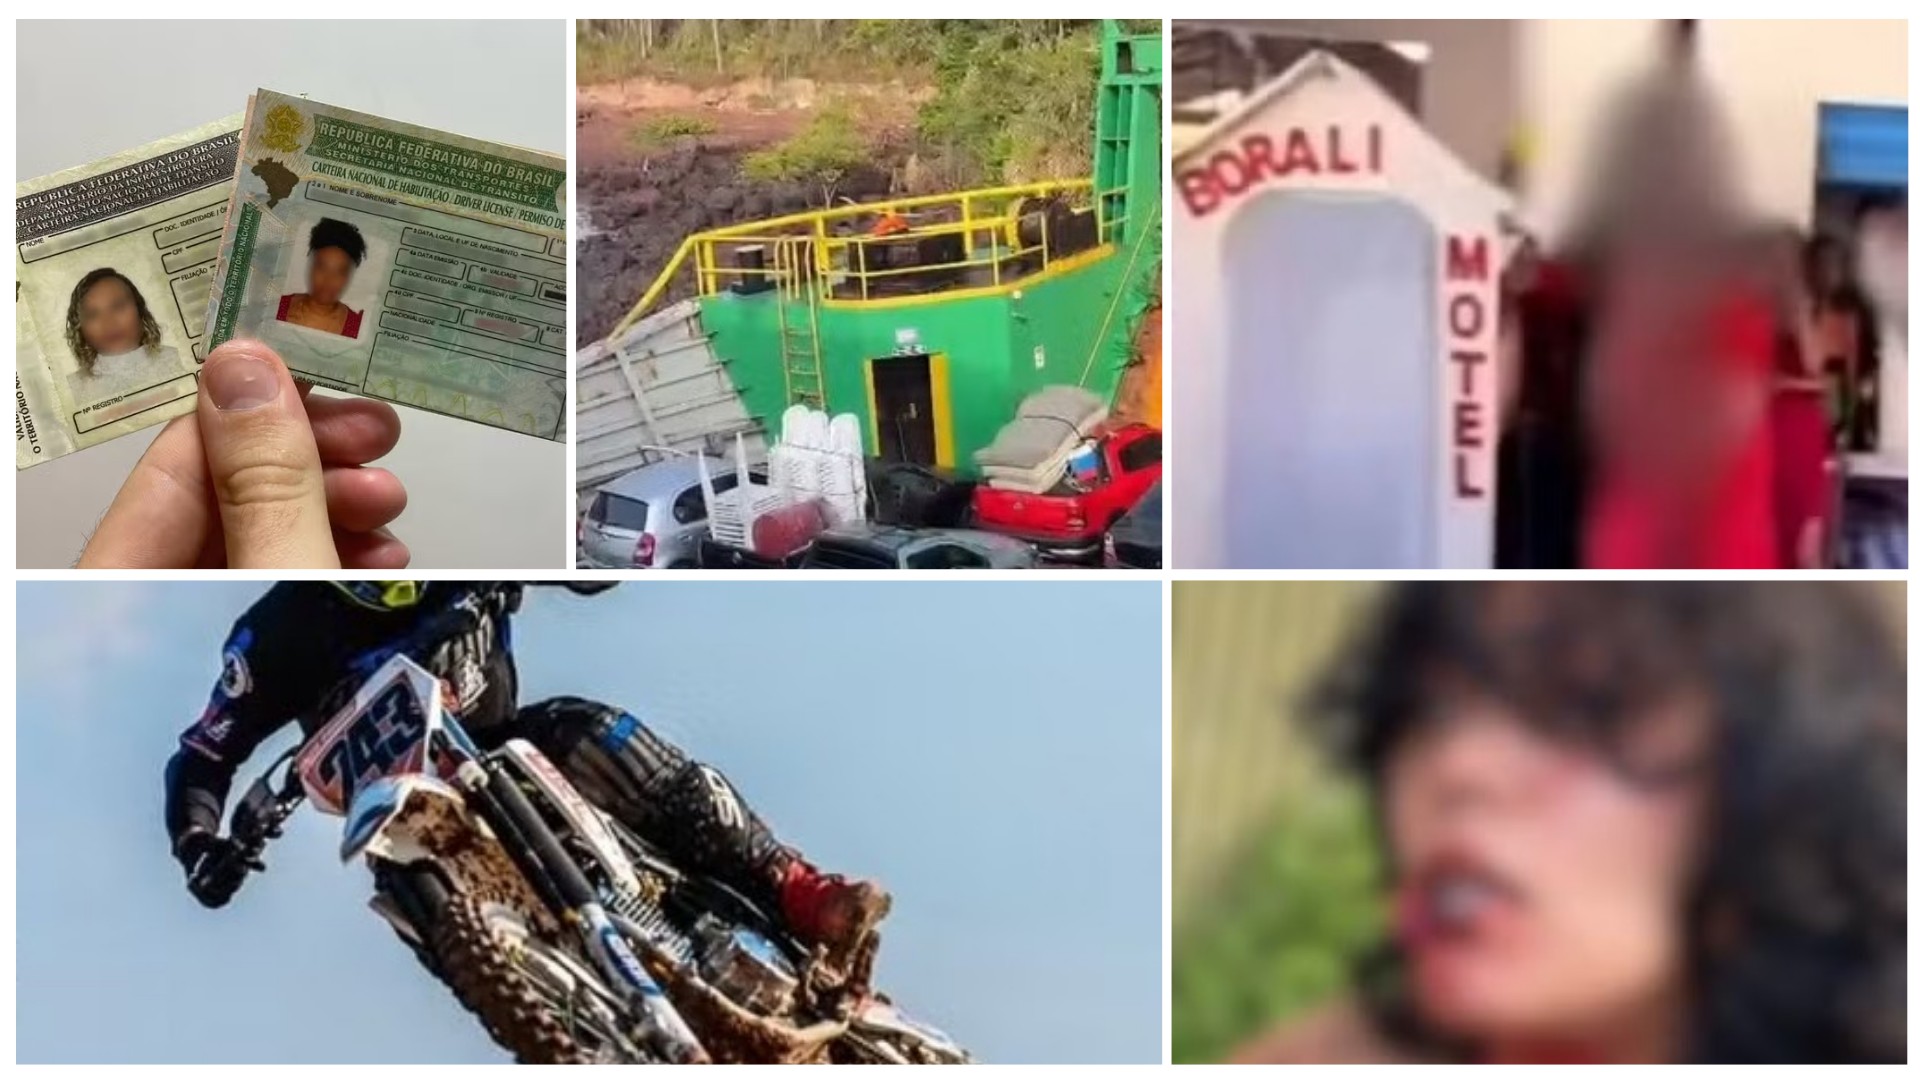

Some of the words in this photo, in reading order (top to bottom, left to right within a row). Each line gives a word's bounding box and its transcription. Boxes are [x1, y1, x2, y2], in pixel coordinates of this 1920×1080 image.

[90, 160, 165, 189] FEDERATIVA
[168, 151, 189, 164] DO
[192, 136, 234, 155] BRASIL
[108, 182, 124, 192] DA
[126, 153, 214, 186] INFRAESTRUTURA
[326, 149, 394, 170] SECRETARIA
[399, 166, 456, 186] NACIONAL
[461, 181, 476, 190] DE
[399, 141, 478, 170] FEDERATIVA
[483, 160, 502, 175] DO
[507, 166, 554, 188] BRASIL
[414, 160, 437, 170] DOS
[444, 167, 529, 193] TRANSPORTES
[16, 198, 101, 228] DEPARTAMENTO
[104, 180, 158, 201] NACIONAL
[160, 176, 171, 184] DE
[312, 161, 346, 179] CARTEIRA
[348, 172, 386, 188] NACIONAL
[388, 180, 398, 190] DE
[454, 194, 483, 209] DRIVER
[483, 200, 514, 218] LICENSE
[518, 209, 553, 226] PERMISO
[330, 184, 348, 194] NOME
[356, 191, 397, 206] SOBRENOME
[28, 214, 78, 232] CARTEIRA
[82, 196, 136, 216] NACIONAL
[138, 192, 152, 200] DE
[180, 210, 215, 226] IDENTIDADE
[26, 238, 44, 248] NOME
[172, 248, 184, 256] CPF
[417, 252, 433, 260] DATA
[390, 310, 436, 326] NACIONALIDADE
[1446, 235, 1489, 499] MOTEL
[16, 391, 38, 444] TERRITÓRIO
[92, 396, 124, 411] REGISTRO
[32, 446, 42, 454] O
